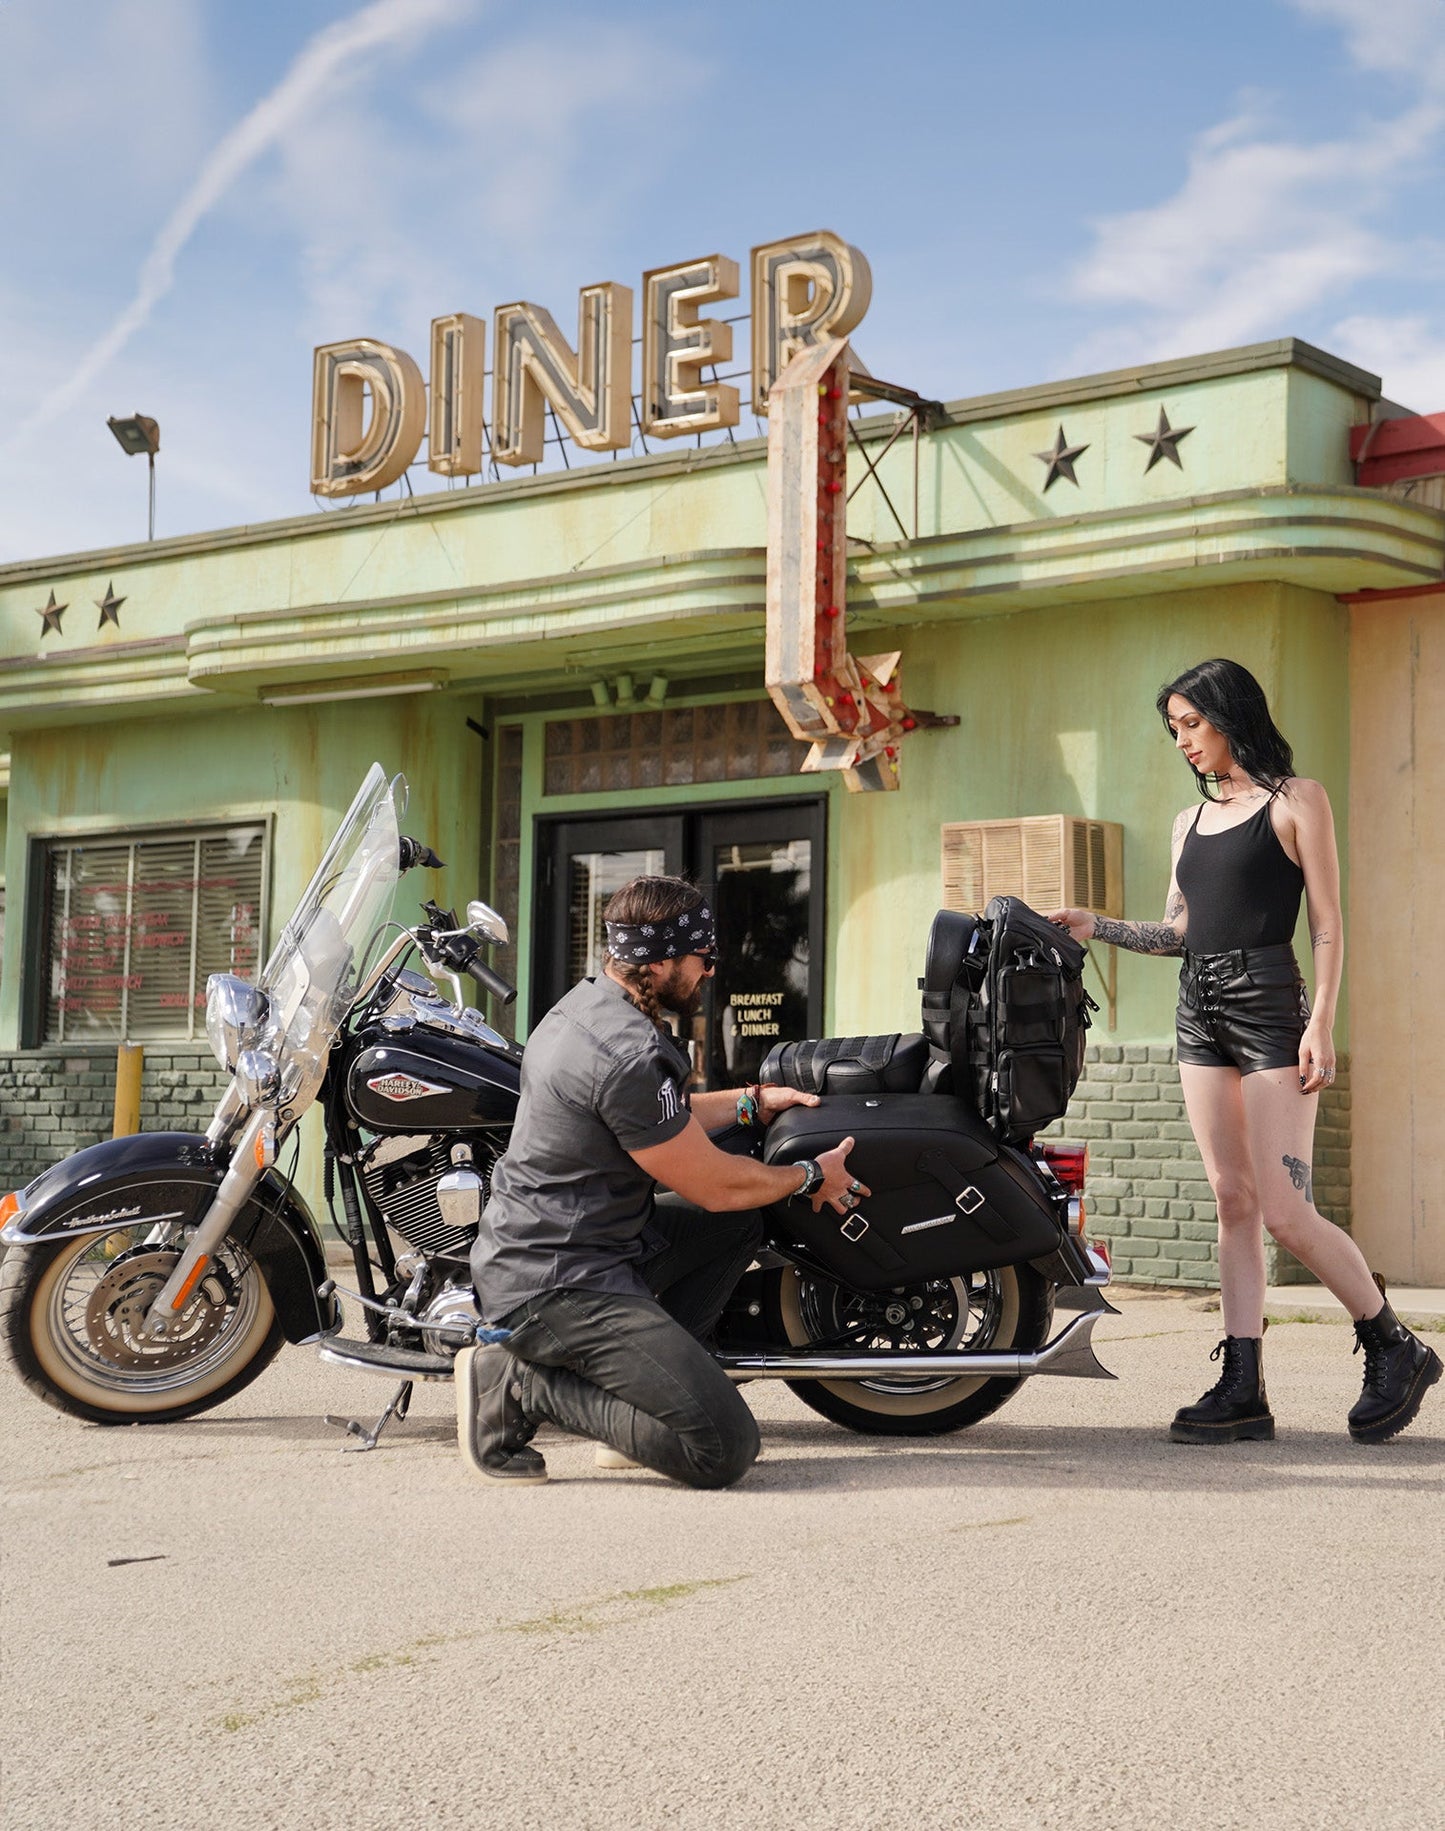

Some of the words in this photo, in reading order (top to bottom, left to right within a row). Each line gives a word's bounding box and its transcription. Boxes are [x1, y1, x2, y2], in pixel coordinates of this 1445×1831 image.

[310, 229, 873, 498] DINER
[730, 993, 784, 1006] BREAKFAST
[737, 1009, 772, 1022] LUNCH
[741, 1023, 780, 1037] DINNER
[376, 1086, 422, 1096] DAVIDSON
